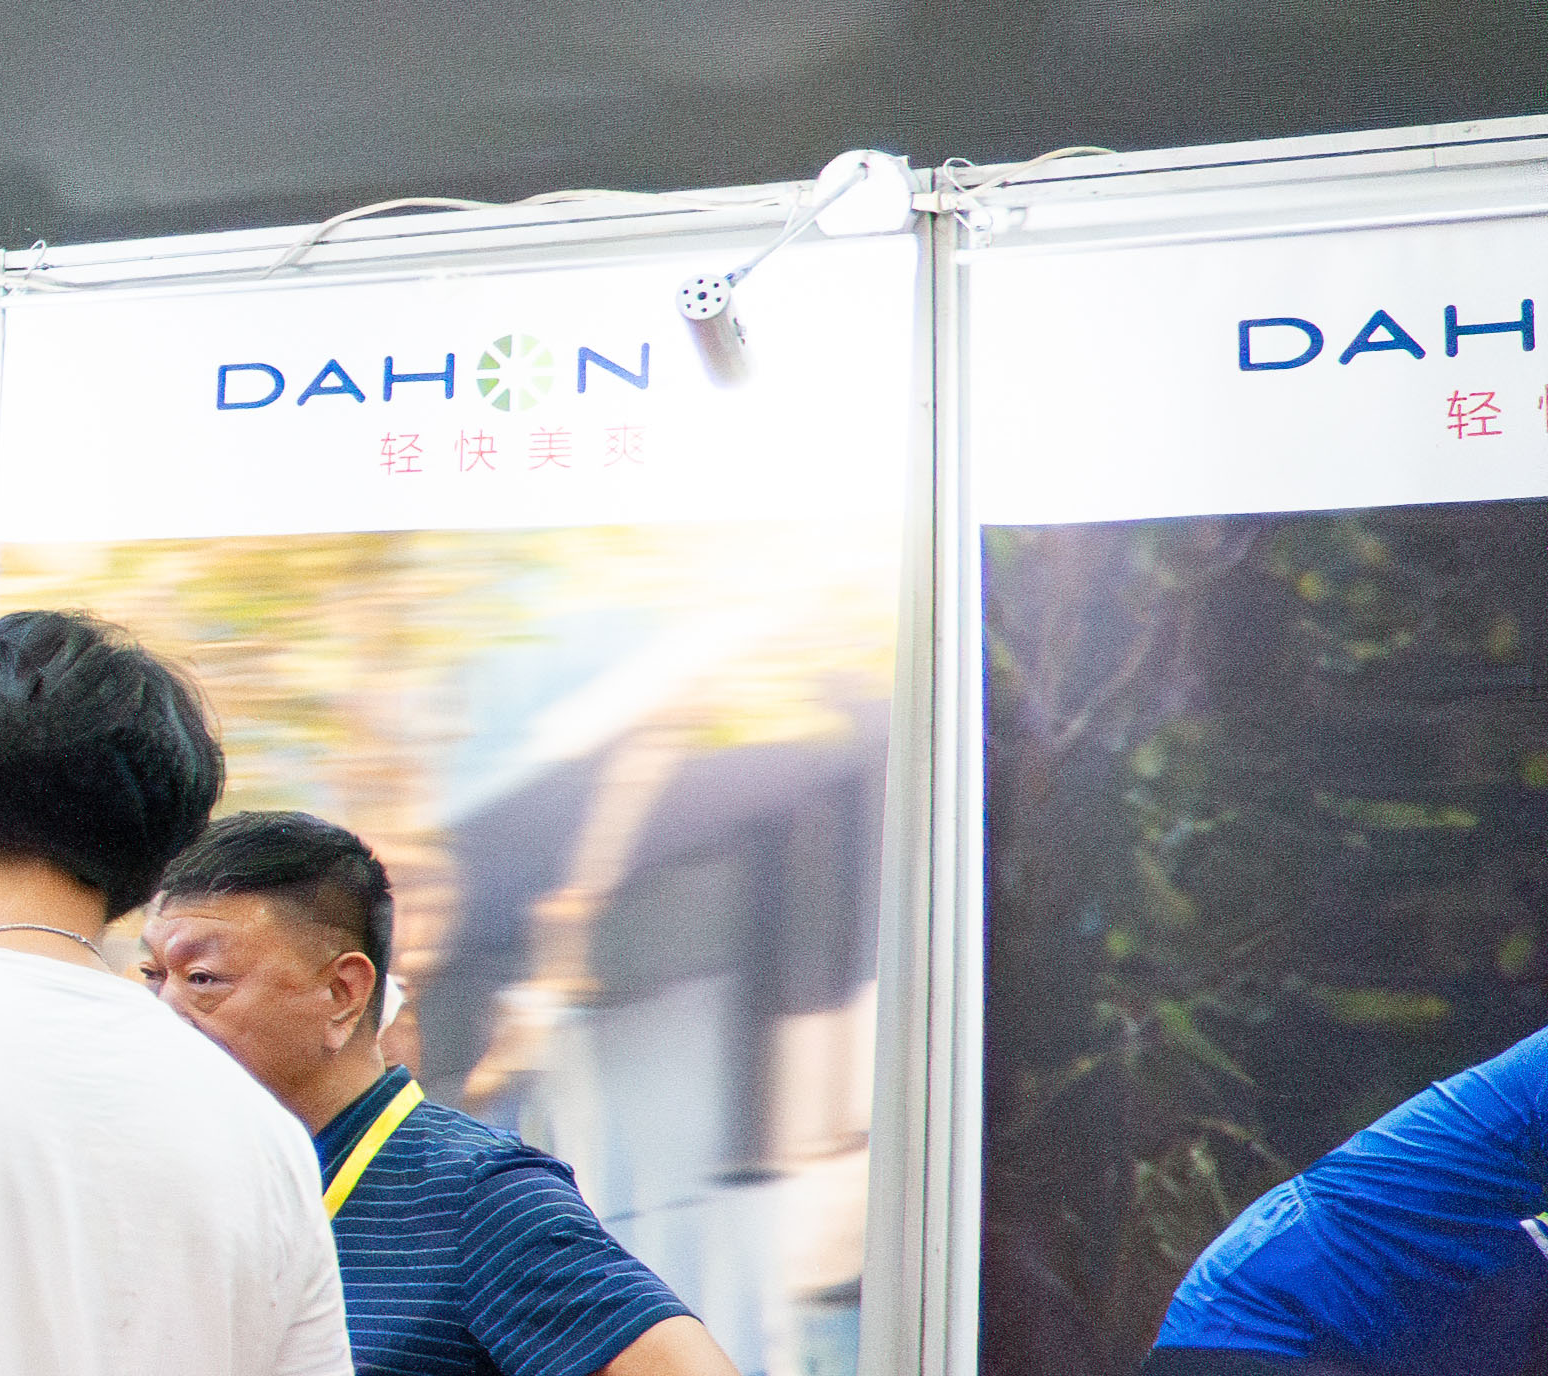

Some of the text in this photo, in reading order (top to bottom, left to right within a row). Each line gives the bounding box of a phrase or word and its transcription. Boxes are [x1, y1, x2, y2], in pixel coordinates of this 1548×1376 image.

[216, 333, 650, 412] DAHON
[379, 424, 646, 476] 轻快美爽
